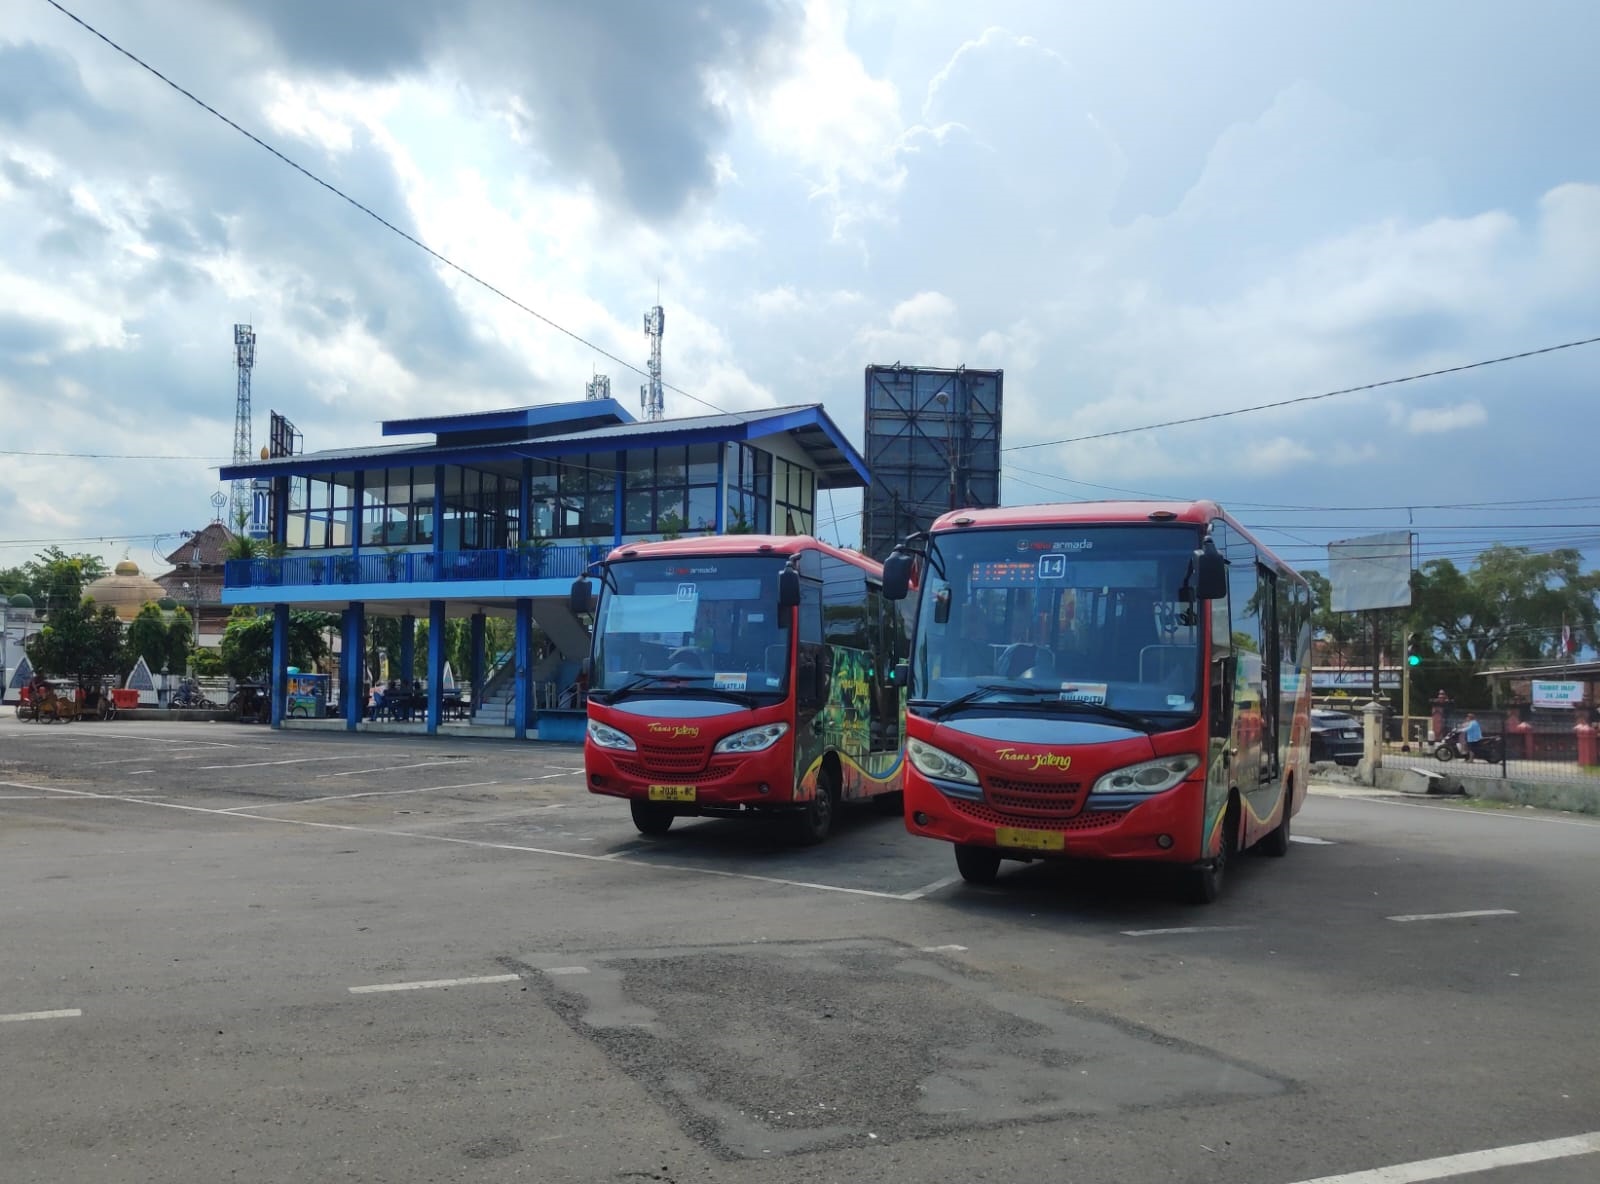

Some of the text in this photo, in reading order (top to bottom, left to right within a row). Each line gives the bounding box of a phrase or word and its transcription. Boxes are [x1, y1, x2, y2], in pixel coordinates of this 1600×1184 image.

[1053, 539, 1092, 549] armada
[1044, 560, 1061, 573] 14
[680, 587, 692, 598] 01
[995, 748, 1072, 771] Trans Jateng
